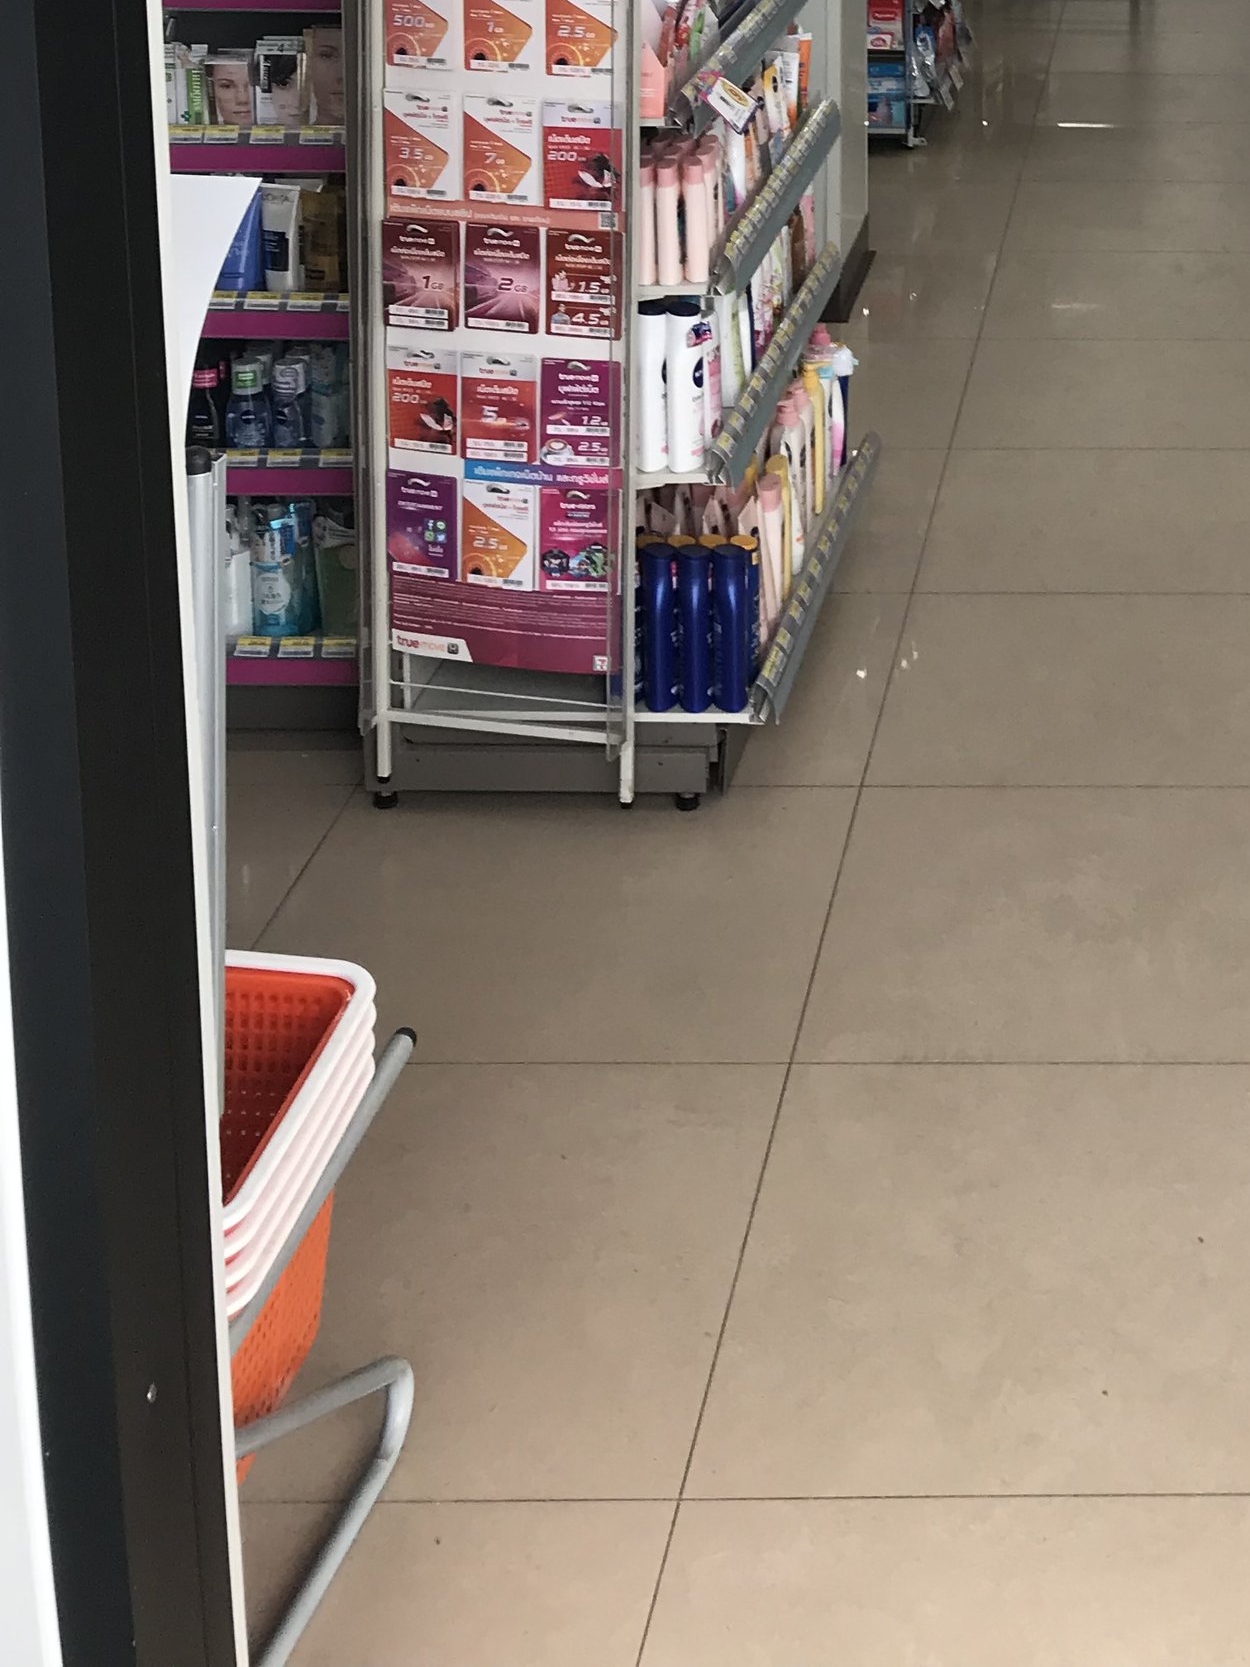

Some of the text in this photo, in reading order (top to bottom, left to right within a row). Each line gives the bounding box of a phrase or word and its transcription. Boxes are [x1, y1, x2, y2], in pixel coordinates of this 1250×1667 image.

[392, 15, 425, 28] 500
[557, 25, 585, 38] 2.5
[547, 150, 578, 162] 200
[422, 275, 431, 290] 1
[498, 277, 514, 291] 2
[392, 392, 419, 403] 200
[473, 537, 498, 550] 2.5
